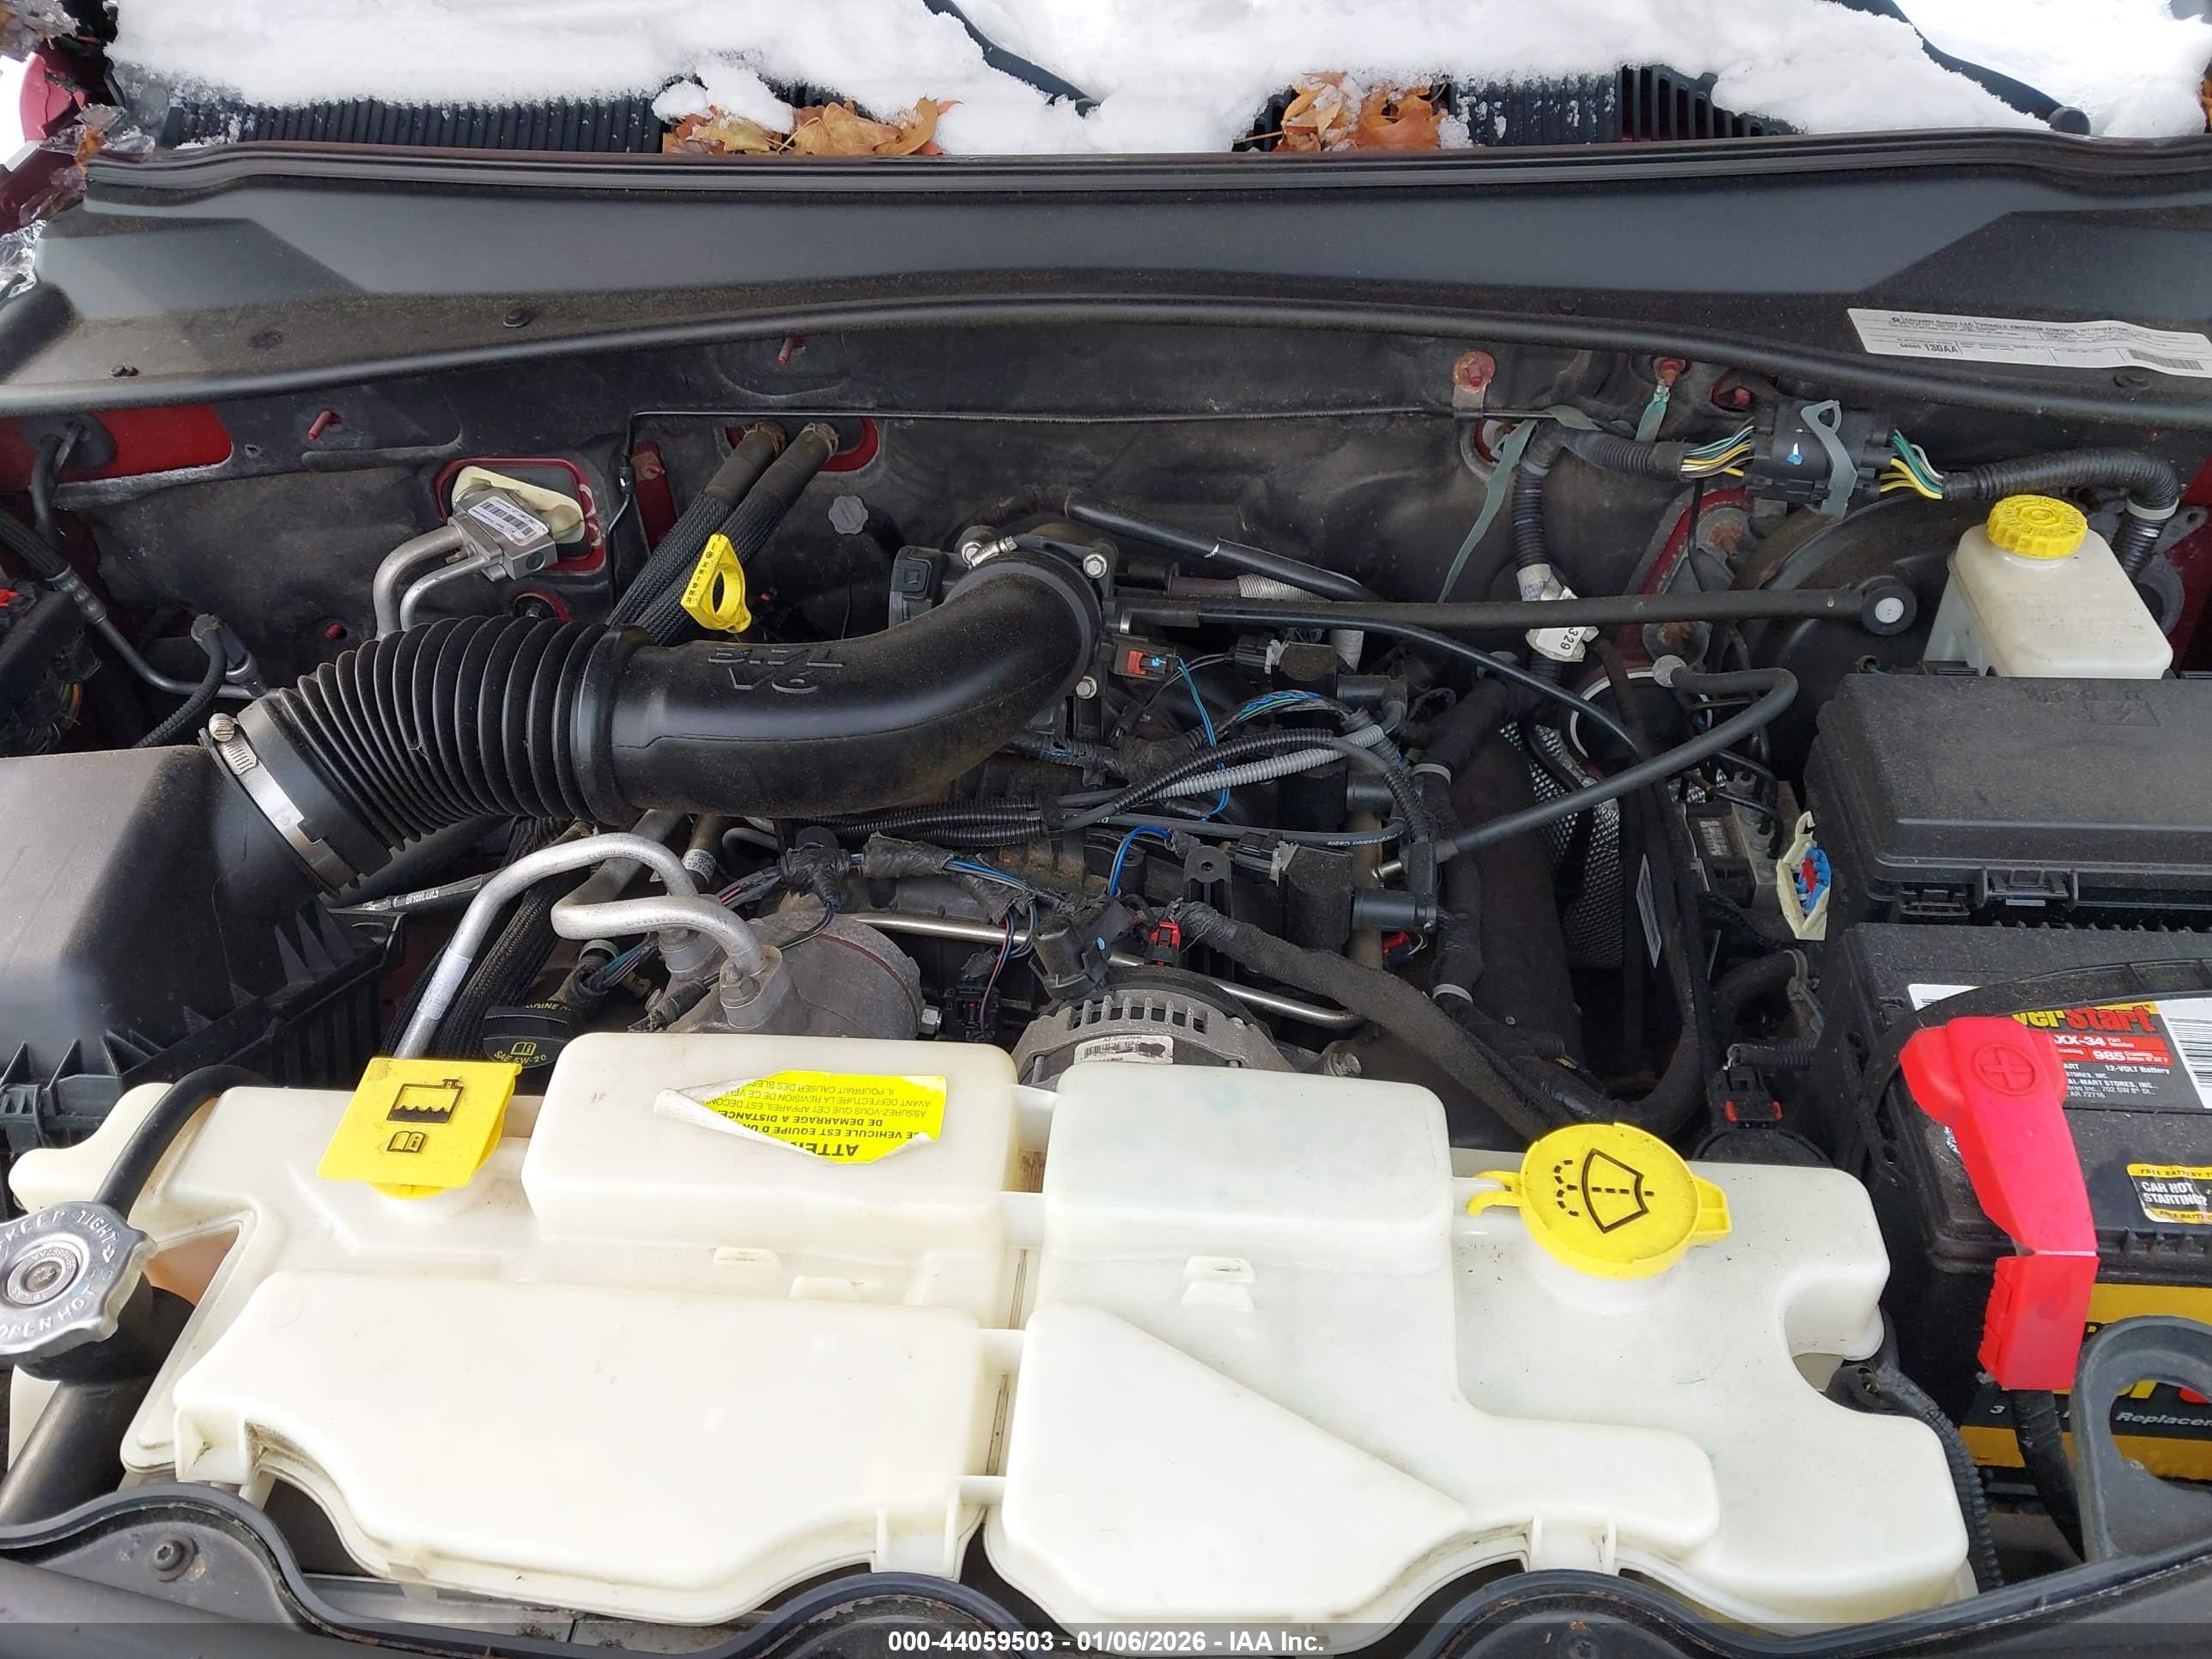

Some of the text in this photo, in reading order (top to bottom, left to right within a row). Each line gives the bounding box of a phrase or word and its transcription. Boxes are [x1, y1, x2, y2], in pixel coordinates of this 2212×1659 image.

[2012, 1005, 2157, 1032] verStart
[494, 1050, 512, 1064] SAE
[2093, 1050, 2126, 1061] 985
[2105, 1064, 2139, 1073] 12-VOLT
[2140, 1066, 2171, 1075] Battery
[777, 1082, 796, 1091] DES
[798, 1085, 836, 1095] CAUSER
[838, 1086, 885, 1096] POURRAIT
[748, 1091, 761, 1100] CE
[763, 1092, 776, 1102] DE
[778, 1093, 822, 1104] REVISION
[824, 1095, 836, 1104] LA
[745, 1101, 763, 1110] EST
[766, 1103, 811, 1114] APPAREIL
[901, 1099, 931, 1108] AVANT
[812, 1104, 830, 1114] CET
[833, 1105, 853, 1115] QUE
[854, 1107, 927, 1117] ASSUREZ-VOUS
[793, 1115, 865, 1127] DEMARRAGE
[868, 1118, 884, 1127] DE
[774, 1126, 817, 1136] EQUIPE
[817, 1127, 842, 1138] EST
[843, 1129, 902, 1139] VEHICULE
[2141, 1182, 2169, 1193] CAR
[2169, 1182, 2195, 1194] NOT
[2142, 1194, 2209, 1206] STARTING?
[76, 1209, 120, 1243] TIGHT
[1990, 1405, 2006, 1415] 3
